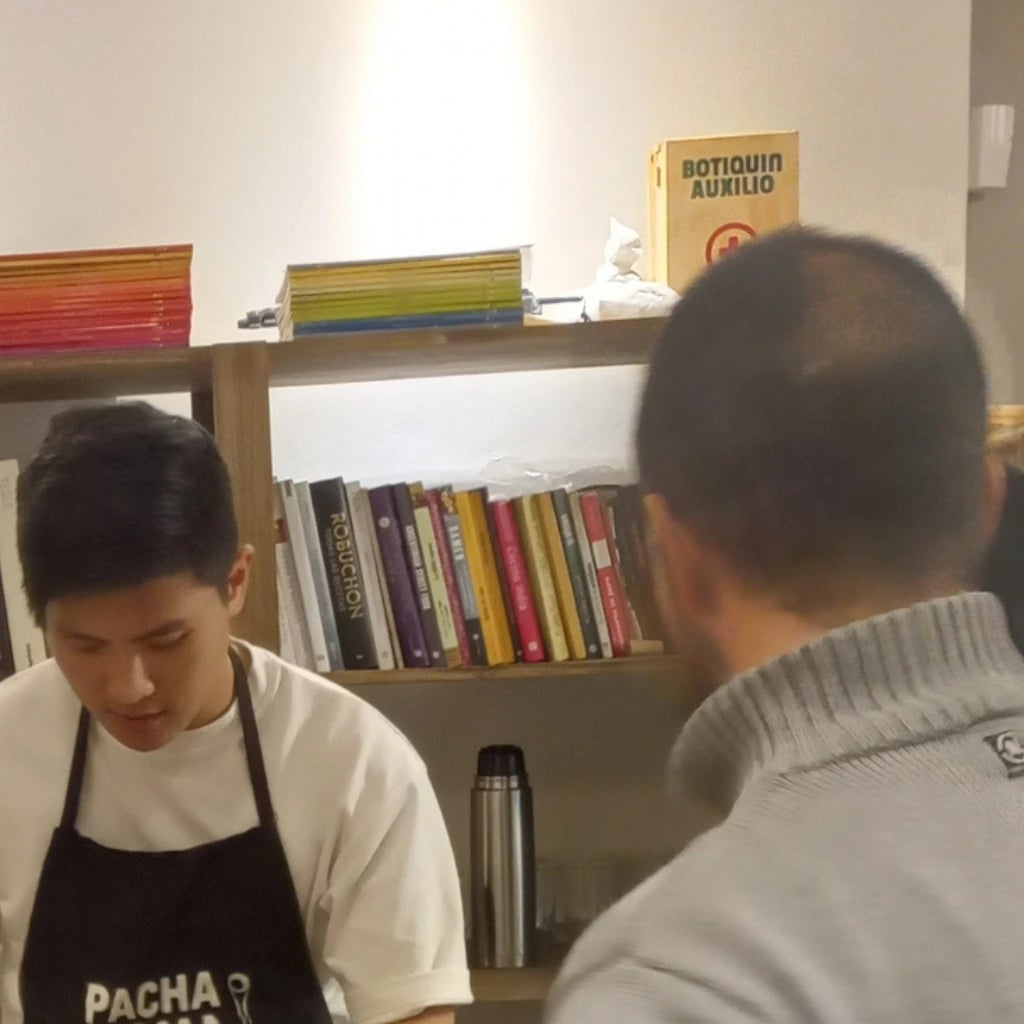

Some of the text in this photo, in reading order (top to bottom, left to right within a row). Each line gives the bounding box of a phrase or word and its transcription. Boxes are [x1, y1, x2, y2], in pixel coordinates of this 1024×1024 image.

[690, 174, 775, 199] AUXILIO
[329, 511, 363, 619] ROBUCHON
[85, 971, 221, 1024] PACHA
